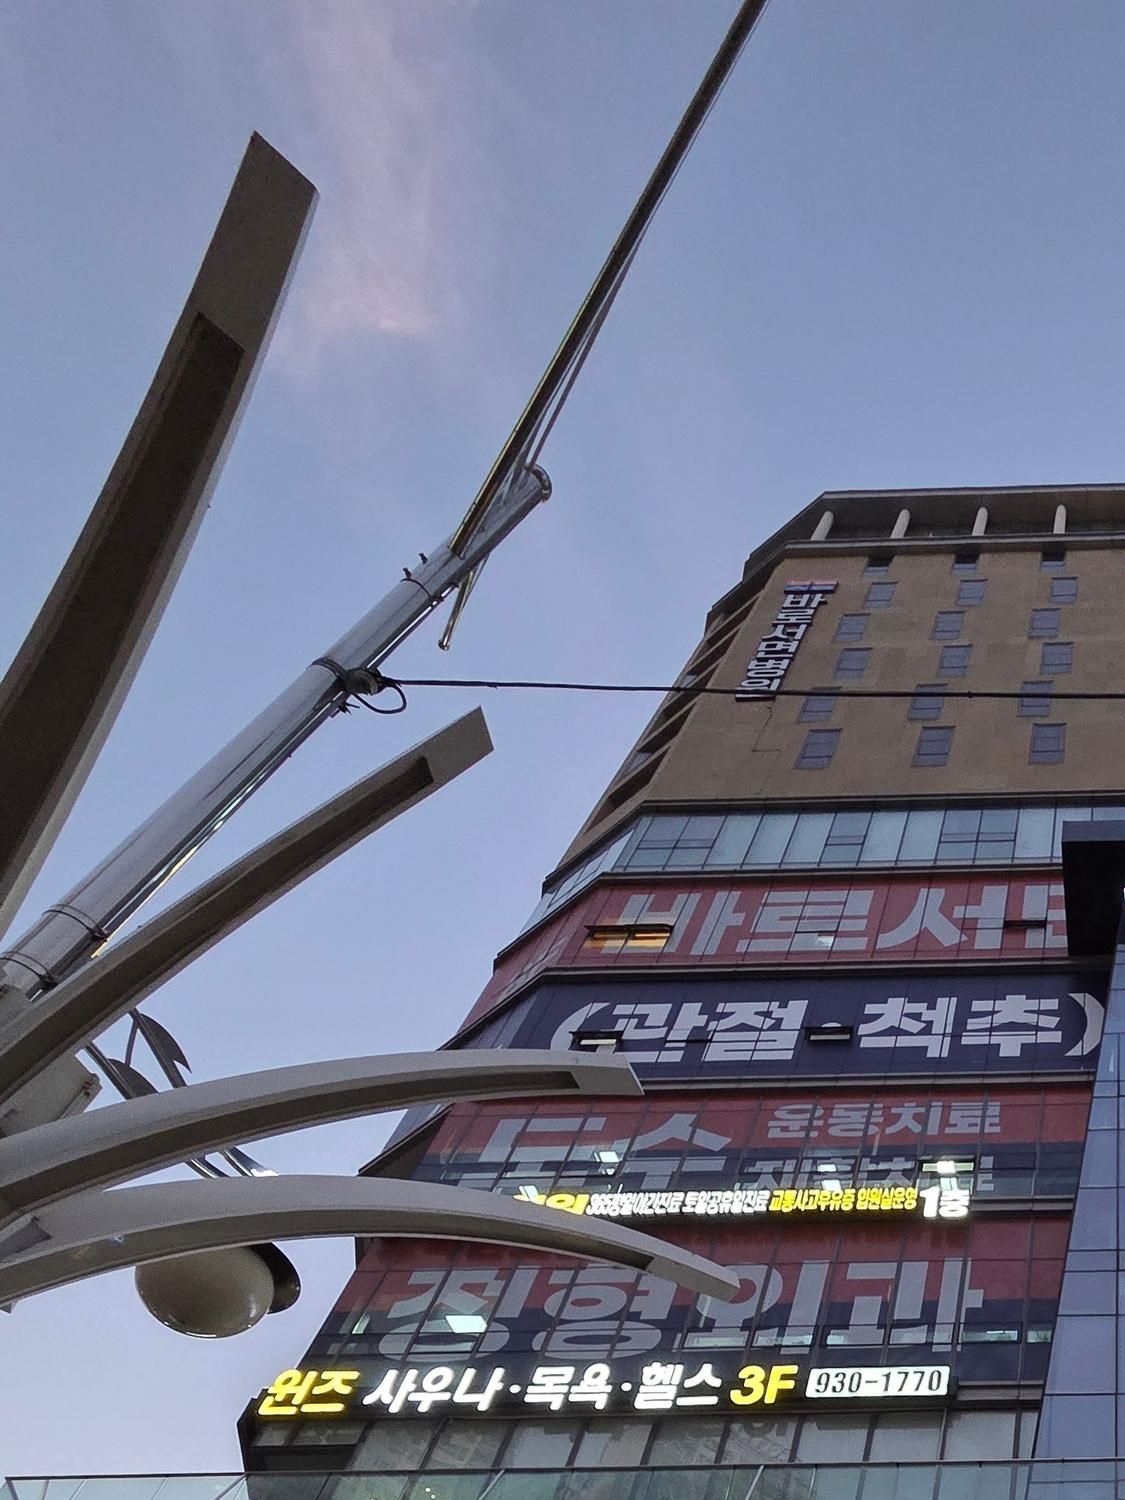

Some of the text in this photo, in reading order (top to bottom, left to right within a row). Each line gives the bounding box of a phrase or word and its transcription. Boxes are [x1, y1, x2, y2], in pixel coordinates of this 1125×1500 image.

[768, 1101, 1001, 1139] 운동치료
[919, 1187, 970, 1218] 1층
[378, 1257, 984, 1363] 정형외과
[729, 1364, 799, 1406] 3F
[814, 1369, 943, 1394] 930-1770
